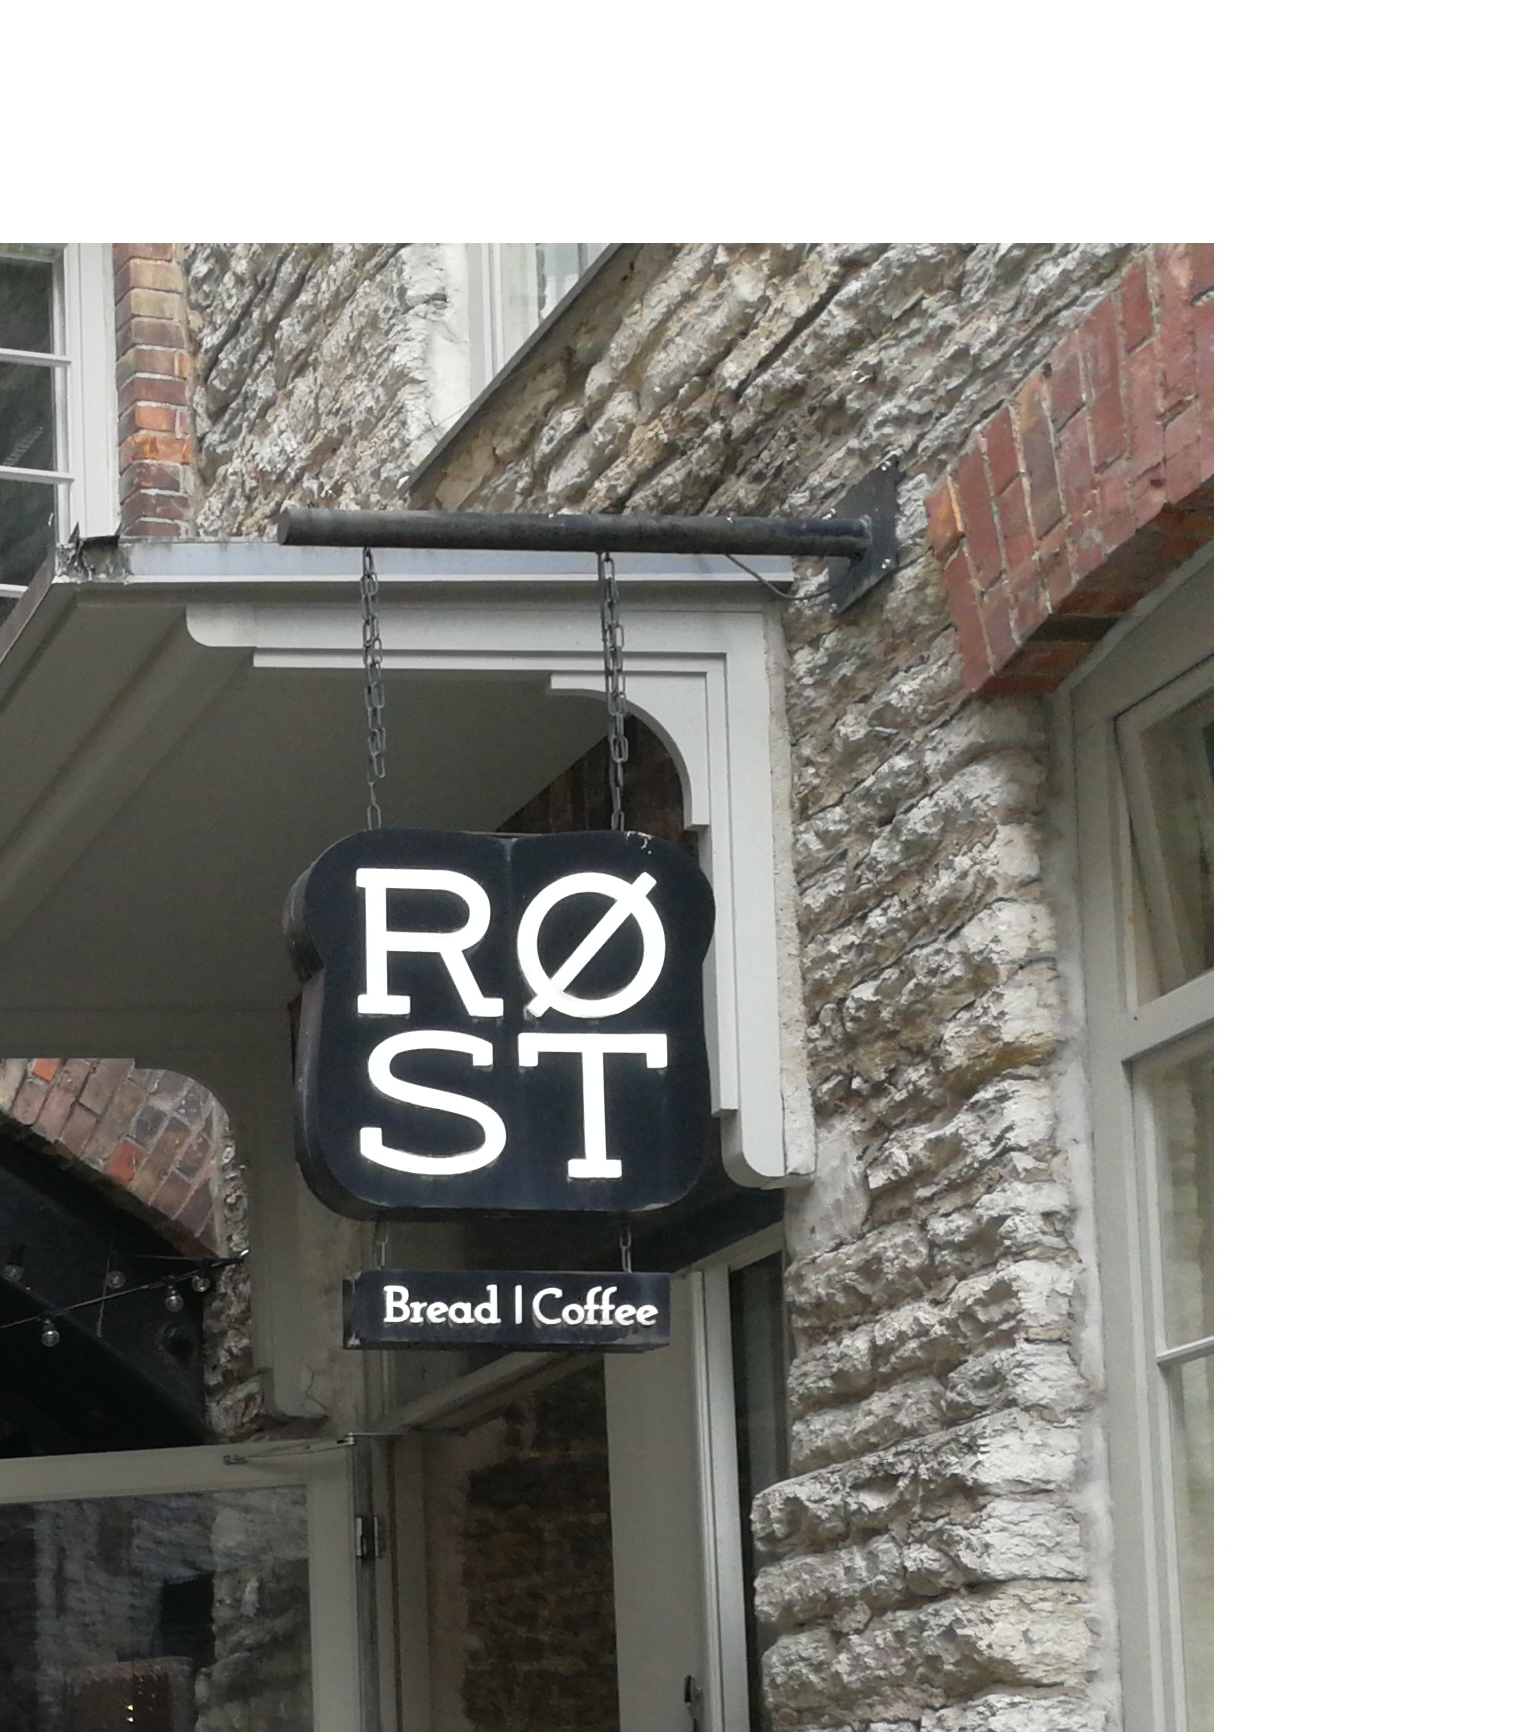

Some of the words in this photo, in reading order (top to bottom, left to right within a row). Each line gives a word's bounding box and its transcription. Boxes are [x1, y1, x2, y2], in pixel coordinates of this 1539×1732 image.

[355, 867, 668, 1019] RØ
[358, 1029, 669, 1180] ST
[382, 1284, 502, 1324] Bread
[532, 1286, 659, 1326] Coffee
